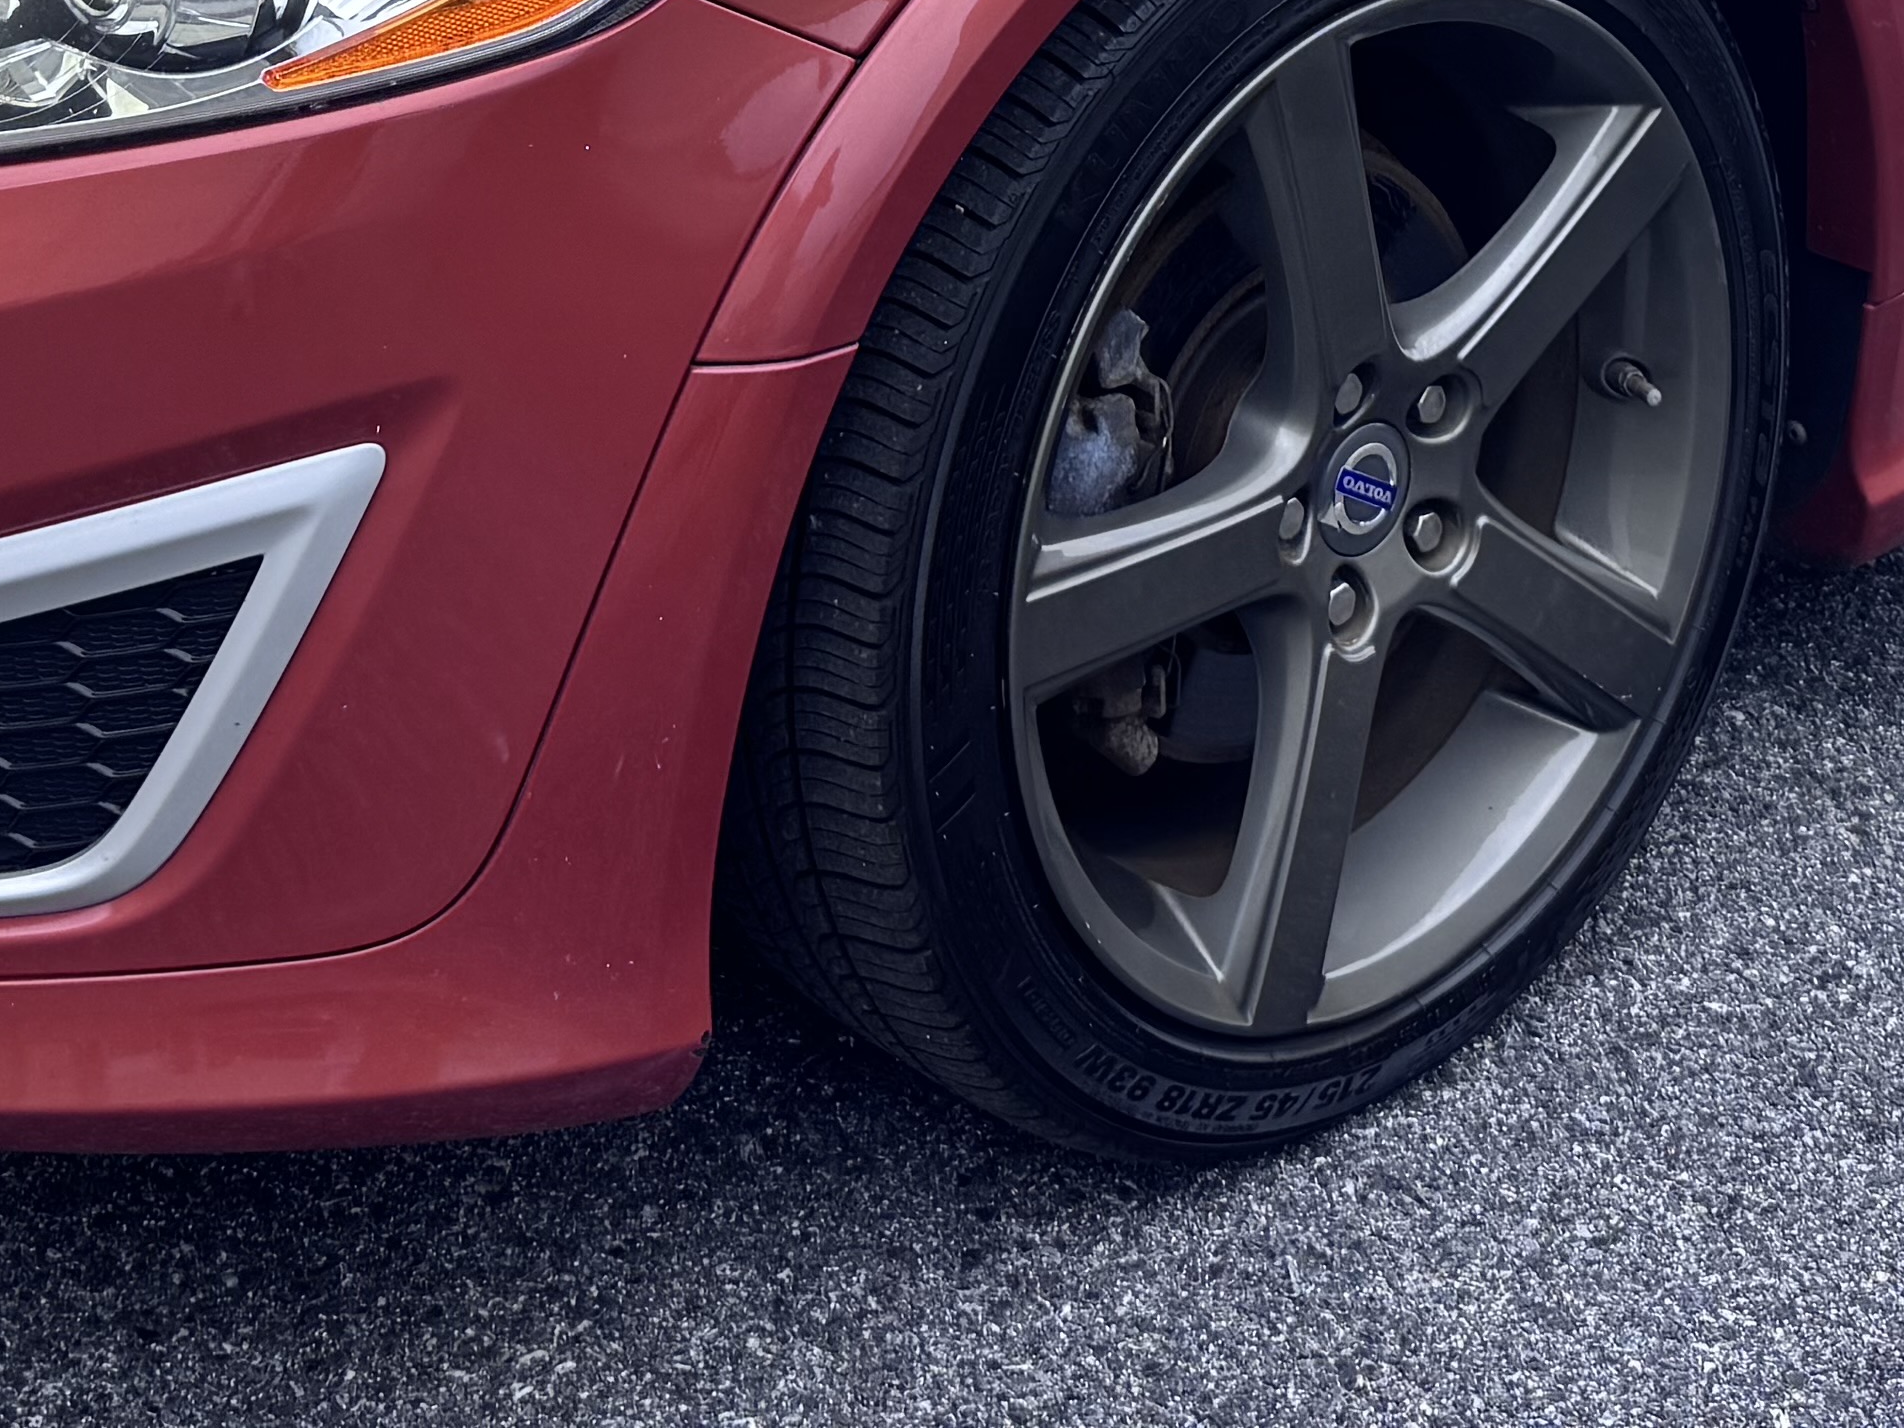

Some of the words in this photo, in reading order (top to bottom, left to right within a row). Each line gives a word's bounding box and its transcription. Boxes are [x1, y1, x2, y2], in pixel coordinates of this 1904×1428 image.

[1342, 475, 1393, 504] VOLVO
[1157, 1083, 1247, 1124] ZR18
[1253, 1063, 1382, 1124] 215/45
